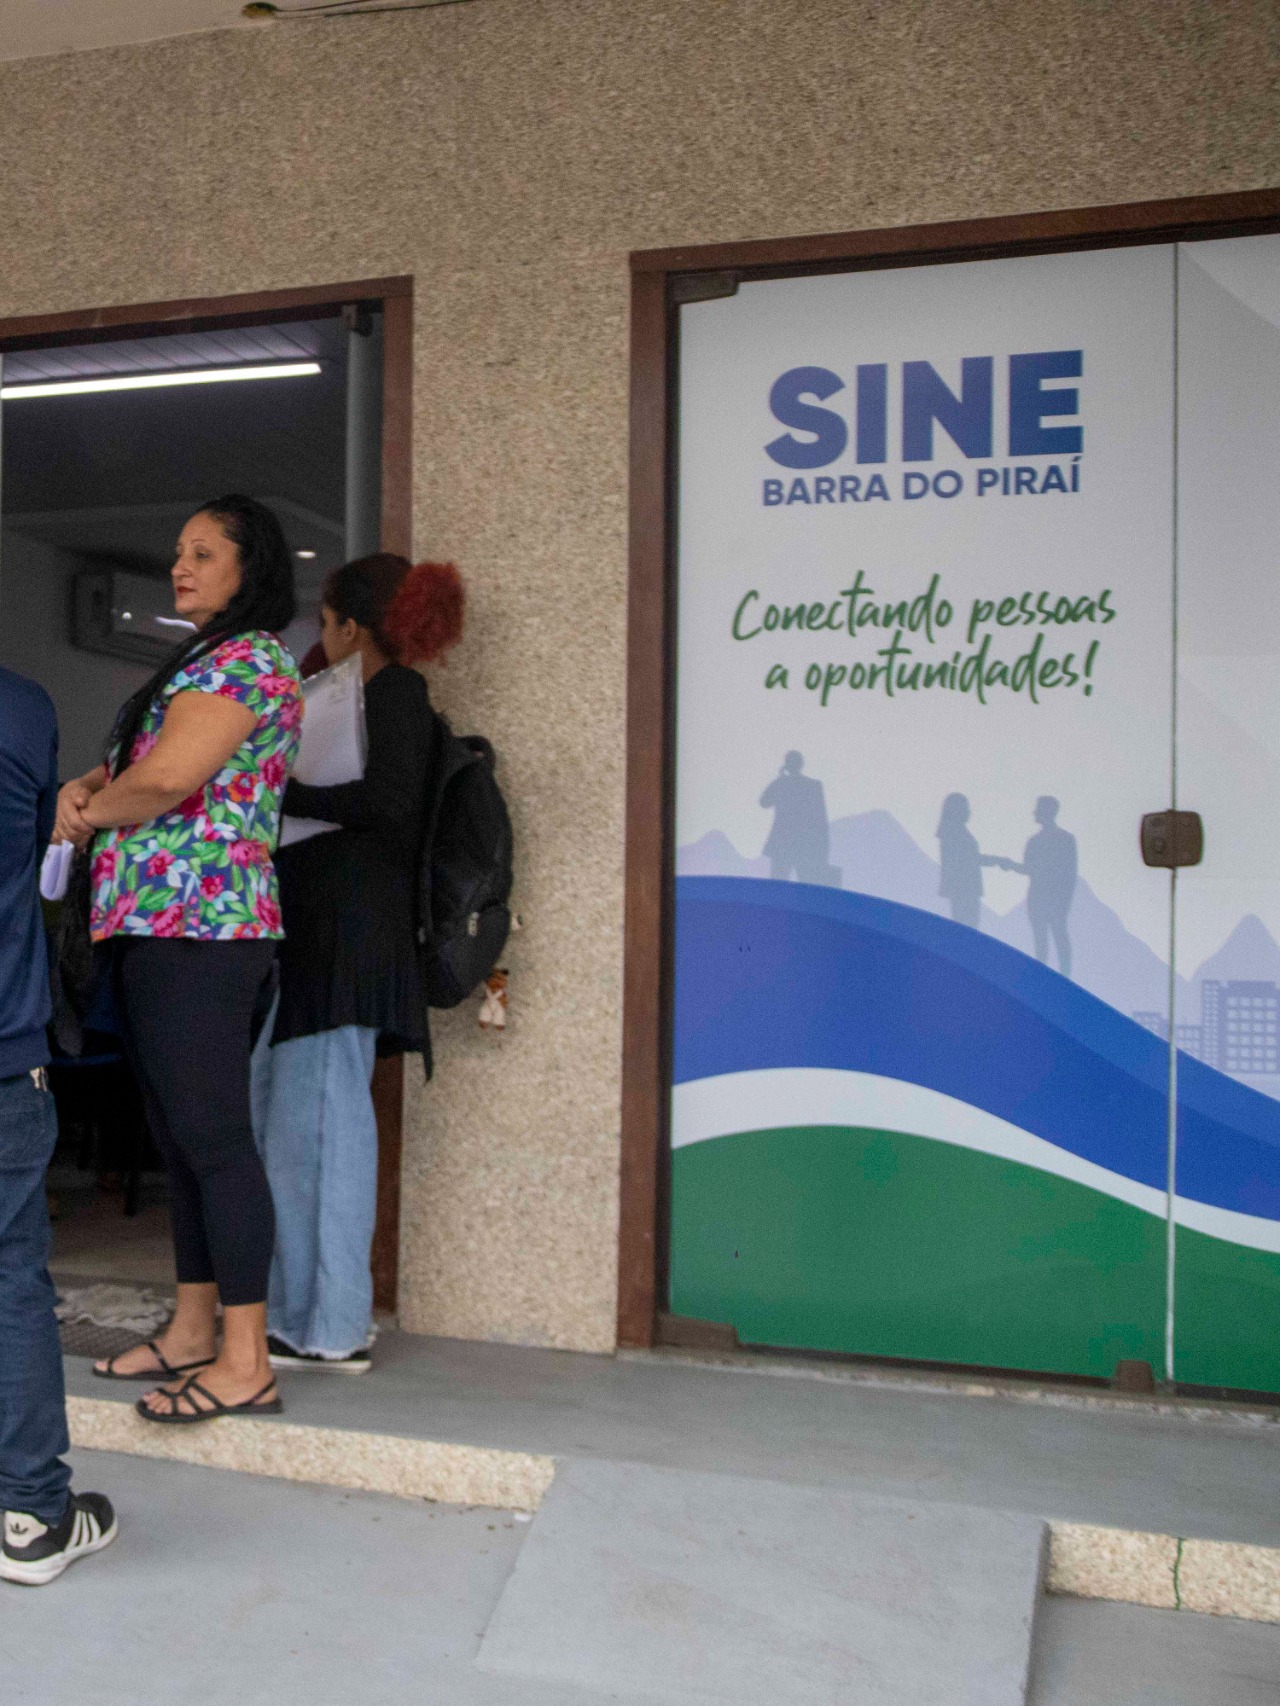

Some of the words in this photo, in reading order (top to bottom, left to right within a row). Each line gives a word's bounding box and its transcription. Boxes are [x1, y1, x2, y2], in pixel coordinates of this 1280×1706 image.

[764, 350, 1084, 469] SINE
[763, 474, 891, 506] BARRA
[903, 470, 964, 500] DO
[977, 456, 1082, 497] PIRAÍ
[732, 570, 953, 644] Conectando
[967, 589, 1117, 644] pessoas
[764, 663, 789, 690] a
[805, 629, 1100, 707] oportunidades!
